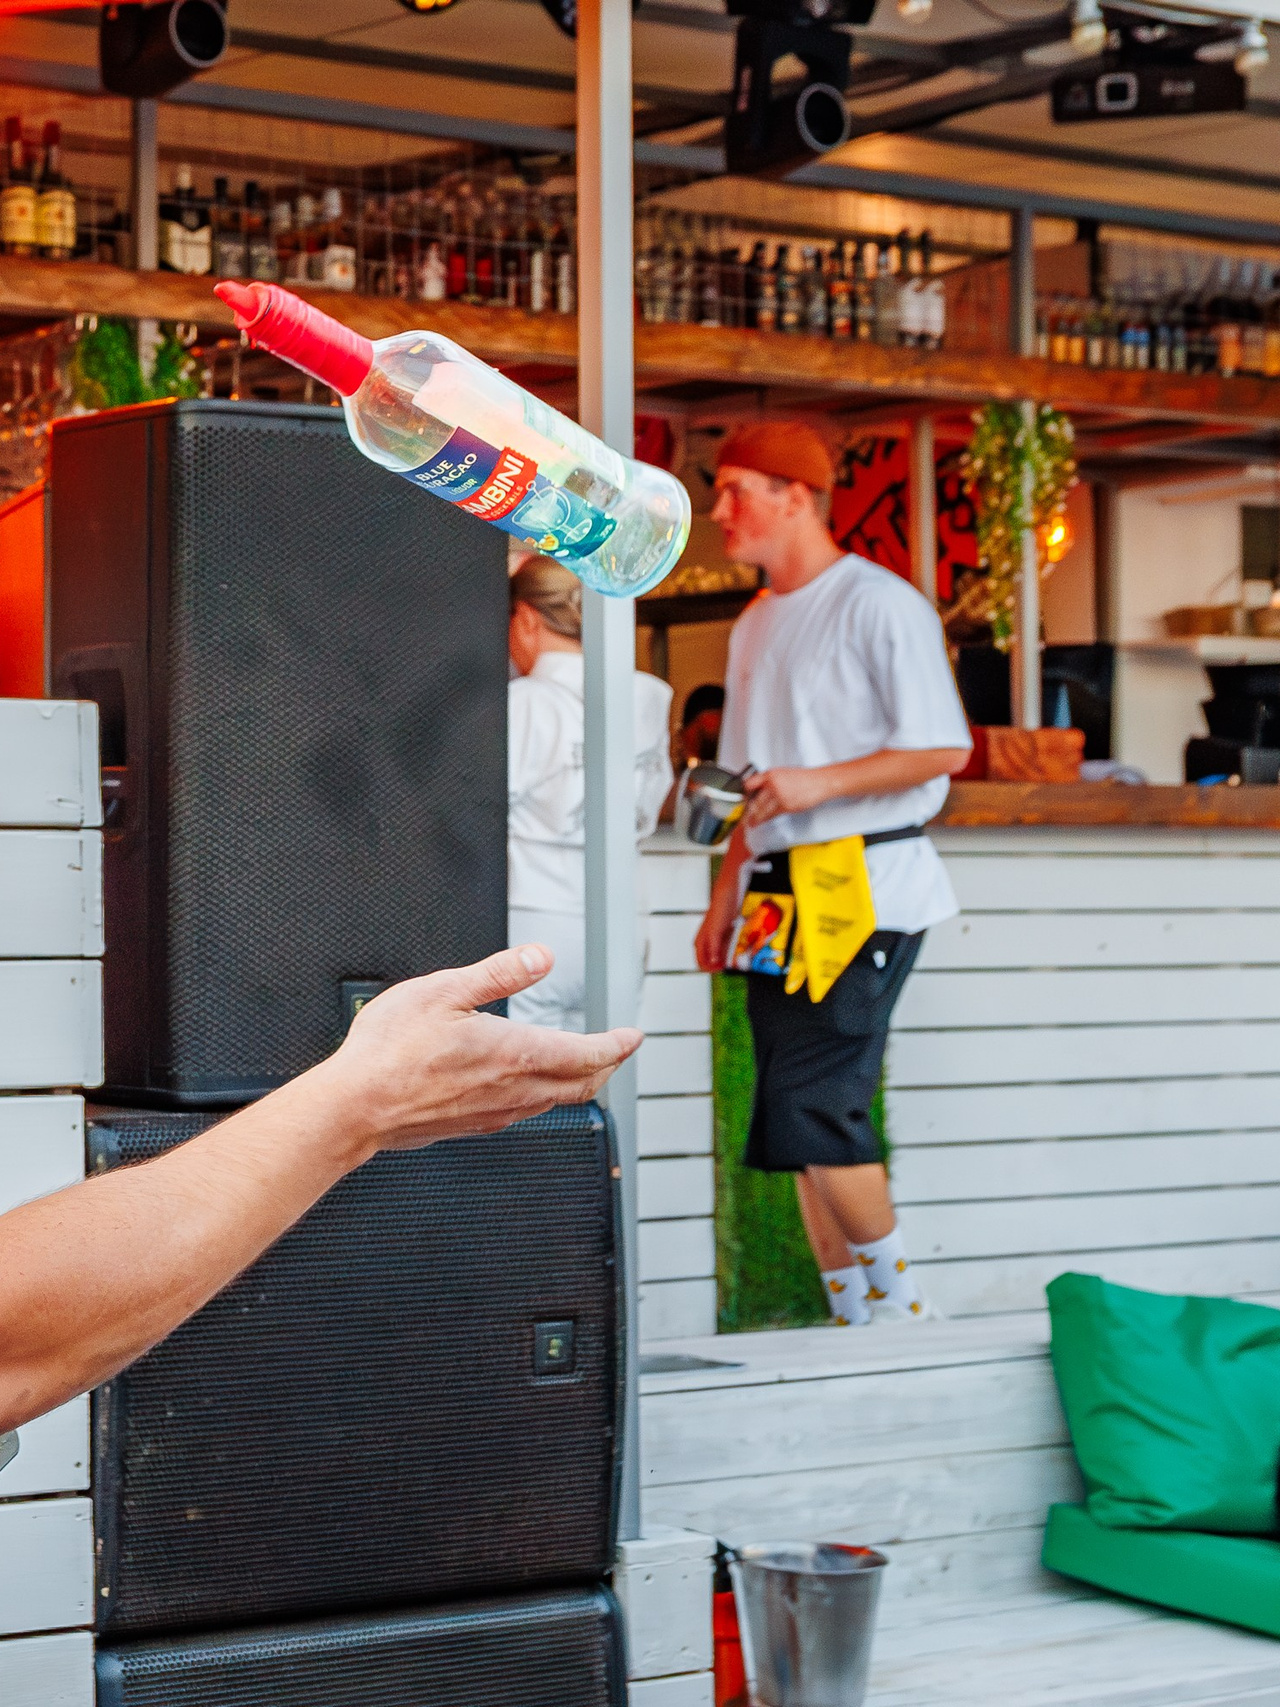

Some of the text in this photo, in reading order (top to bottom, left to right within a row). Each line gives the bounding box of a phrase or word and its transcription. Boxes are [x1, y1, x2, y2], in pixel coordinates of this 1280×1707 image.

[415, 460, 453, 481] BLUE
[421, 453, 477, 489] URACAO
[462, 454, 524, 514] AMBINI
